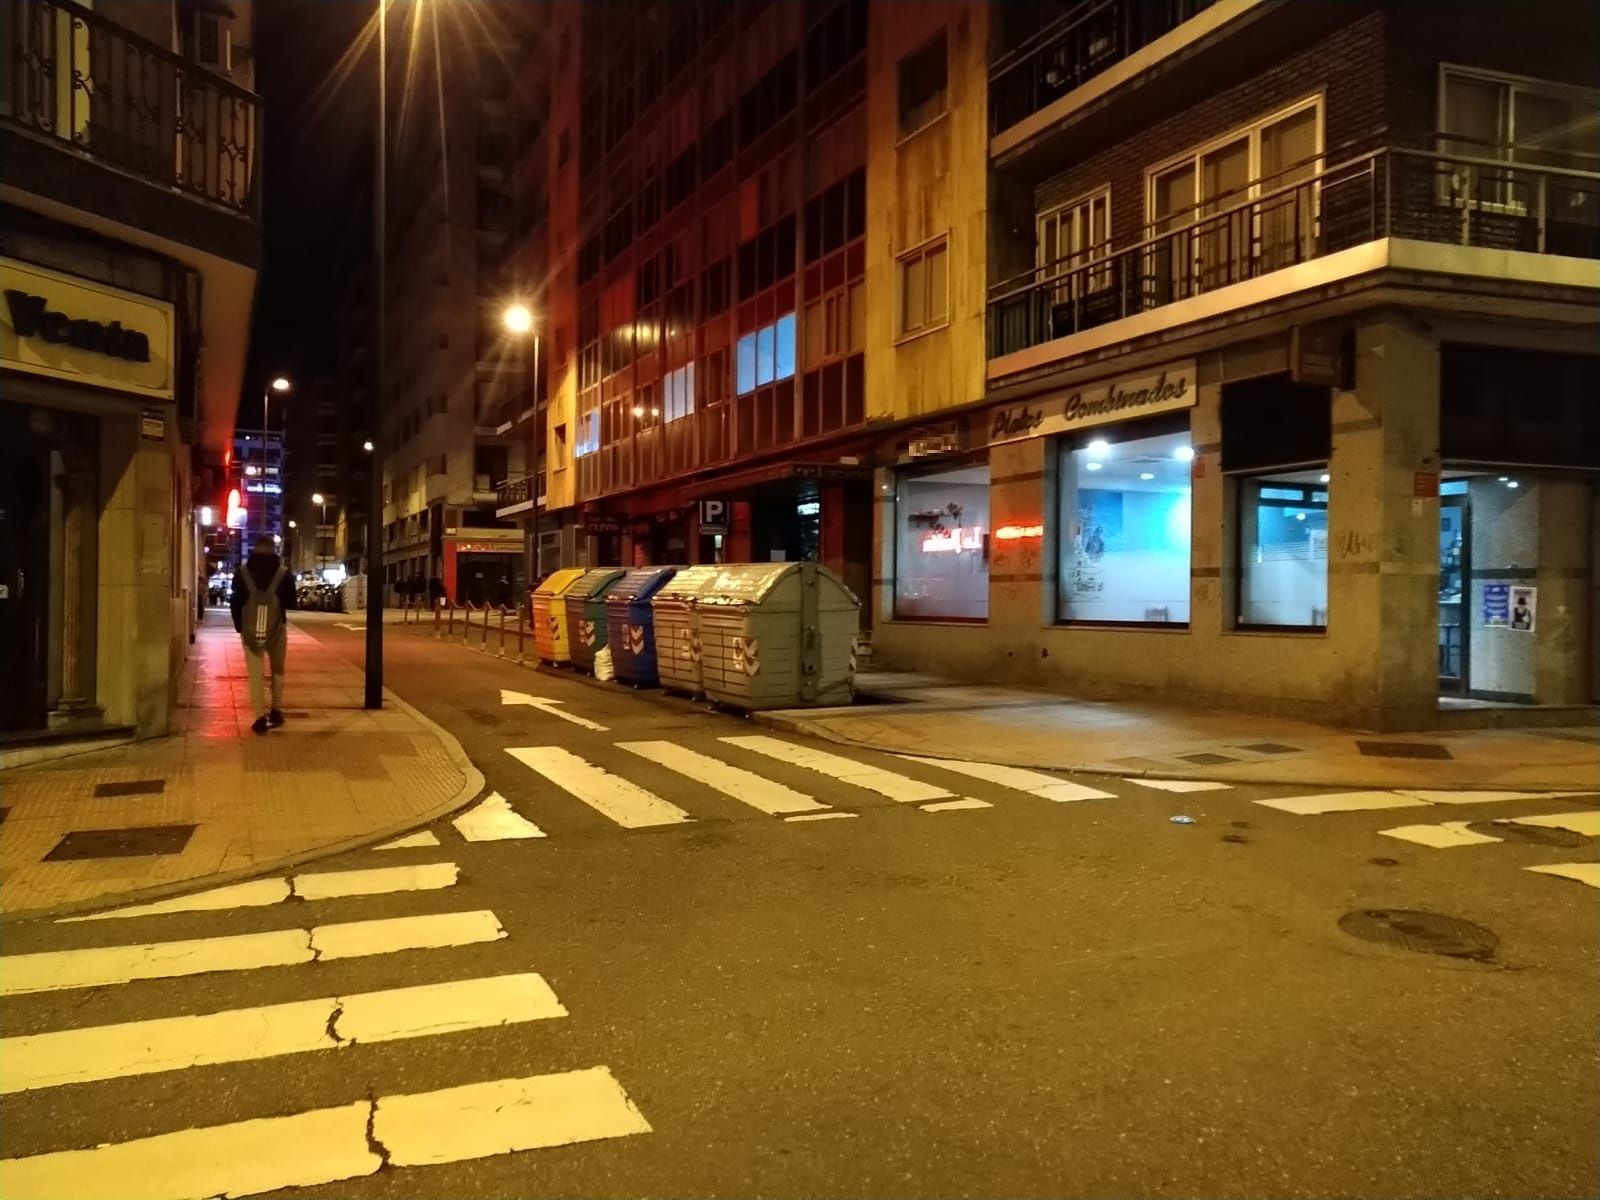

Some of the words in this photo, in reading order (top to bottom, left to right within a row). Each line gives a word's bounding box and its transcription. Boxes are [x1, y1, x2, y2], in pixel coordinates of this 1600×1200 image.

[991, 407, 1045, 439] Platos
[1063, 371, 1189, 421] Combinados
[706, 500, 723, 523] P
